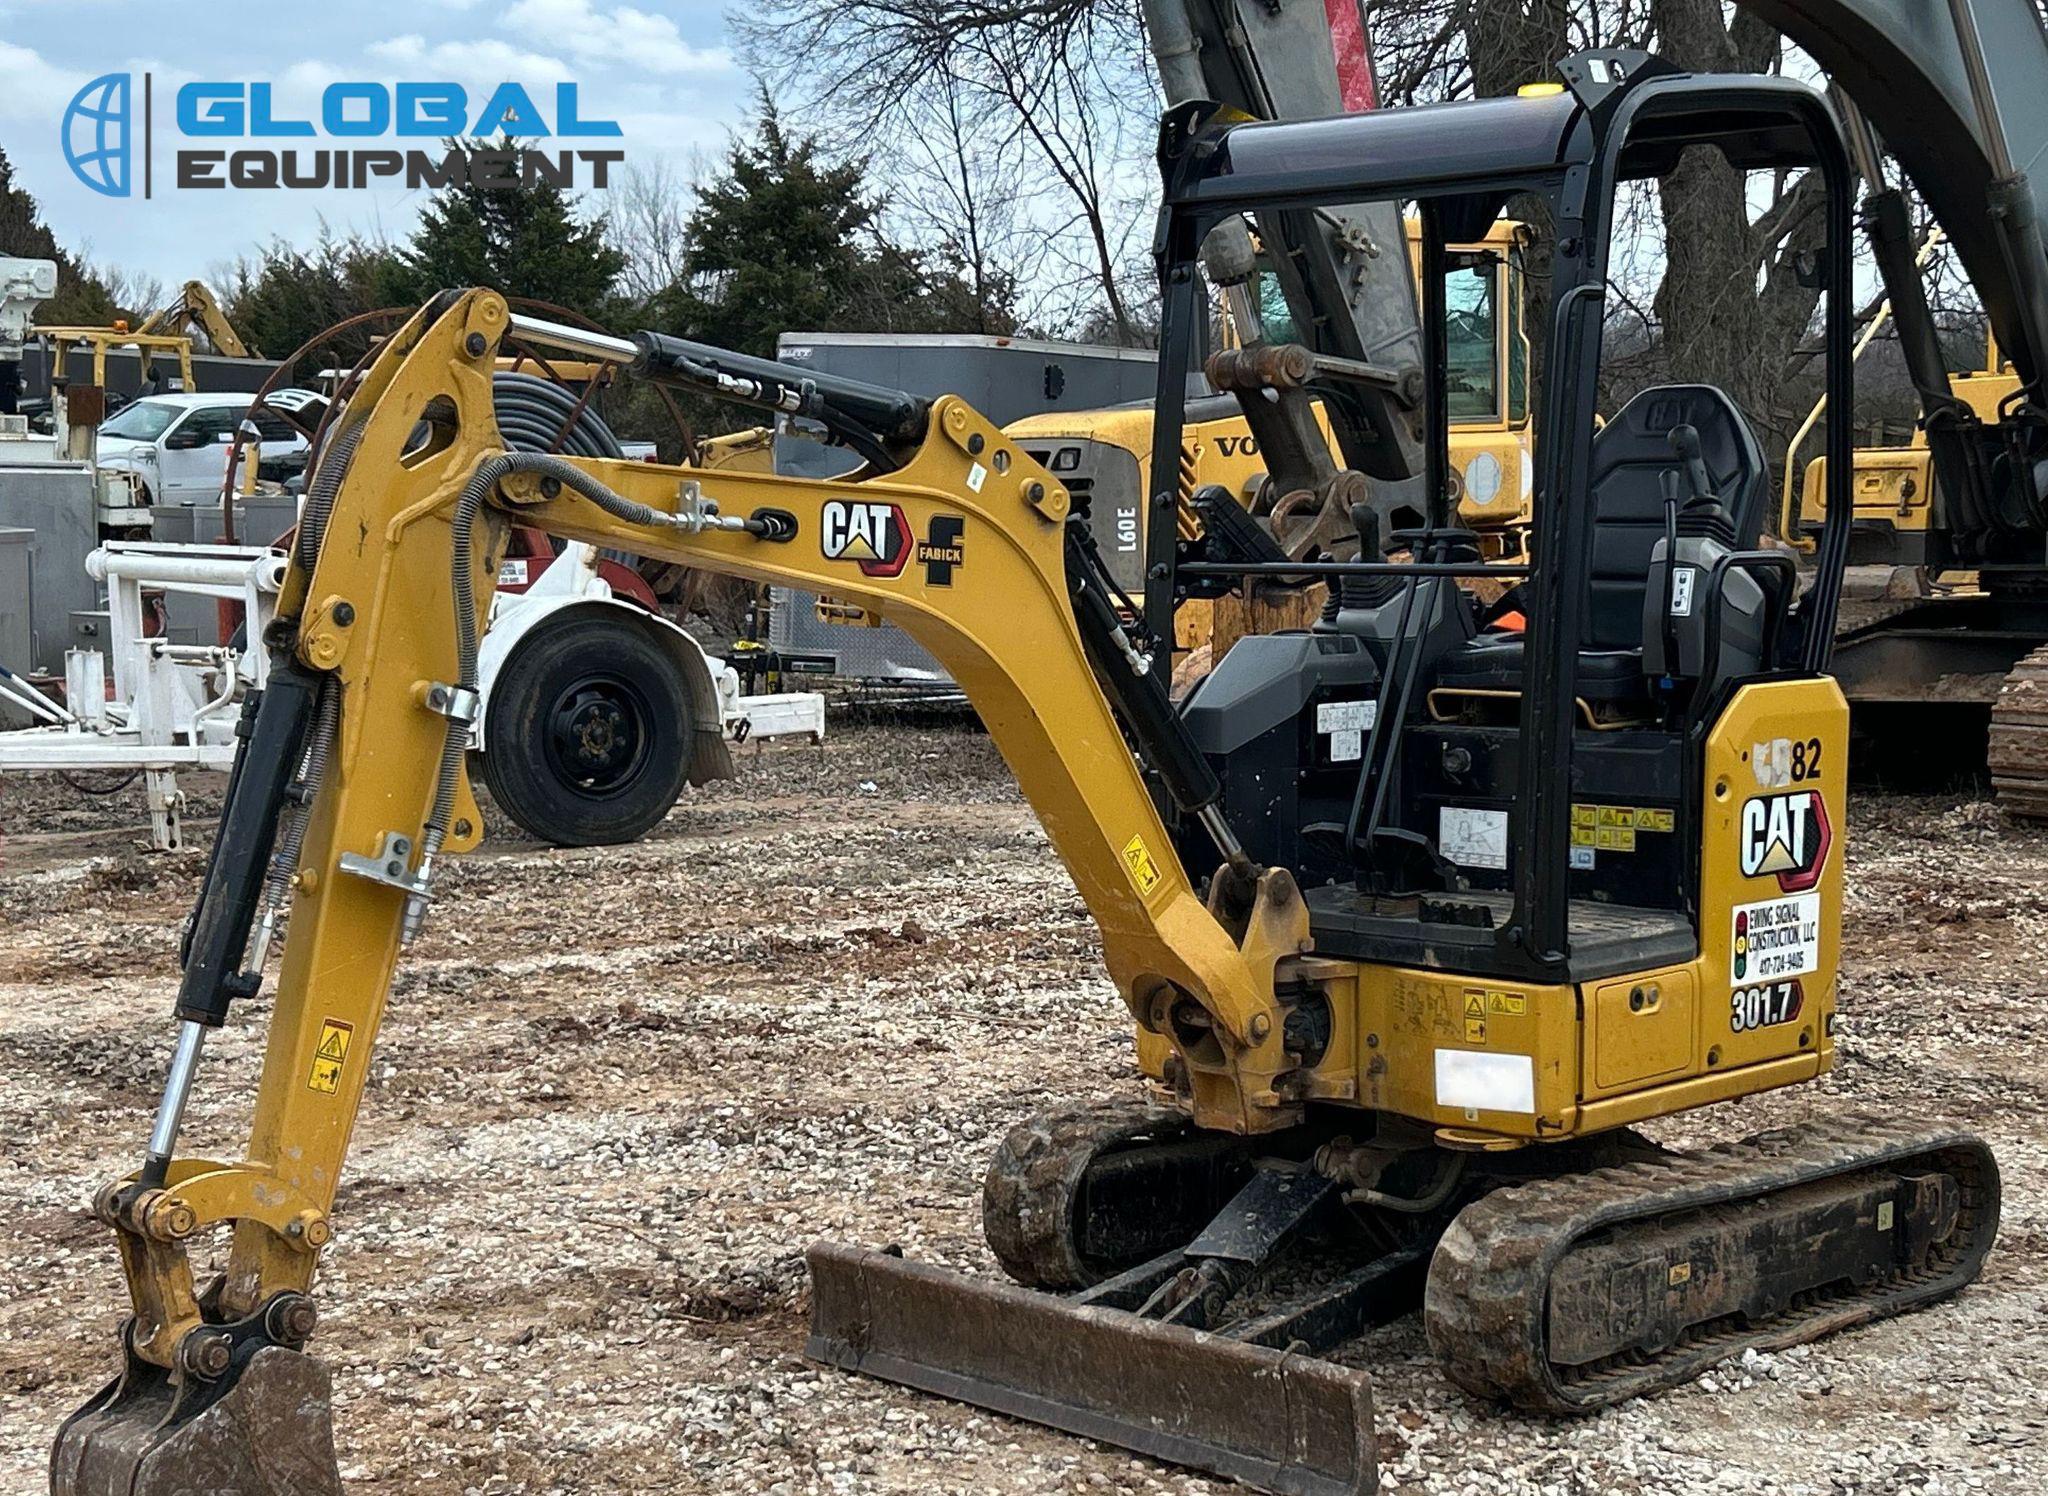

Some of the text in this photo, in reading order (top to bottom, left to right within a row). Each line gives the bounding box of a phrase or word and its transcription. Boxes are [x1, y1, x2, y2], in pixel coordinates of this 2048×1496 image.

[823, 501, 891, 560] CAT
[1117, 507, 1136, 551] L60E
[919, 547, 961, 562] FABICK
[1791, 738, 1821, 782] 82
[1742, 793, 1811, 875] CAT
[1750, 902, 1799, 929] EWING SIGNAL
[1803, 921, 1816, 942] LLC
[1732, 982, 1791, 1031] 301.7
